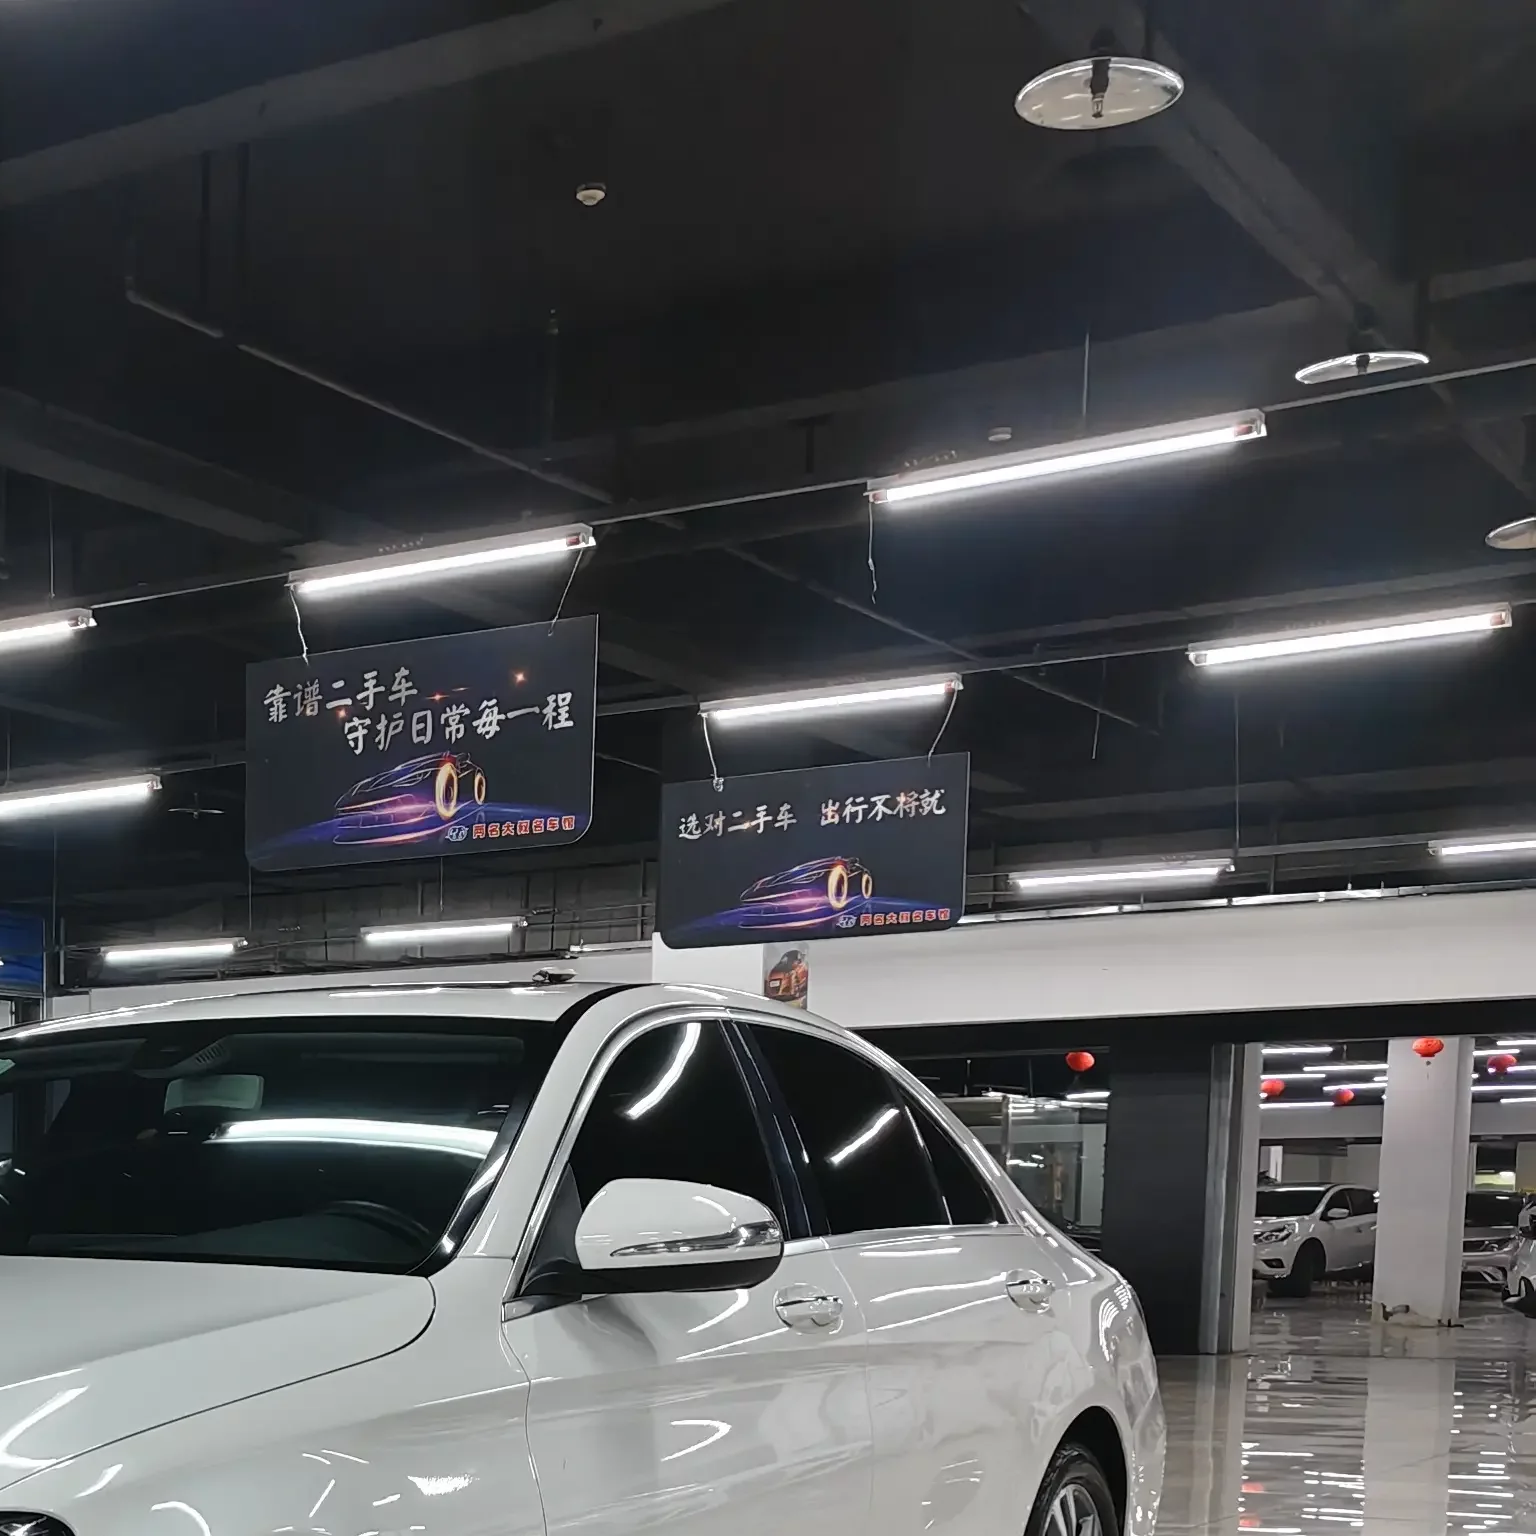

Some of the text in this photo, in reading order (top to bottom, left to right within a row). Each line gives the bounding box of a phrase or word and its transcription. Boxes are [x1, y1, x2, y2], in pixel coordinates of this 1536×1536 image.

[264, 667, 418, 723] 靠谱二手车
[344, 691, 575, 755] 守护日常每一程
[472, 815, 576, 839] 两名大叔名车馆
[678, 789, 947, 840] 选对二手车 出行不将就
